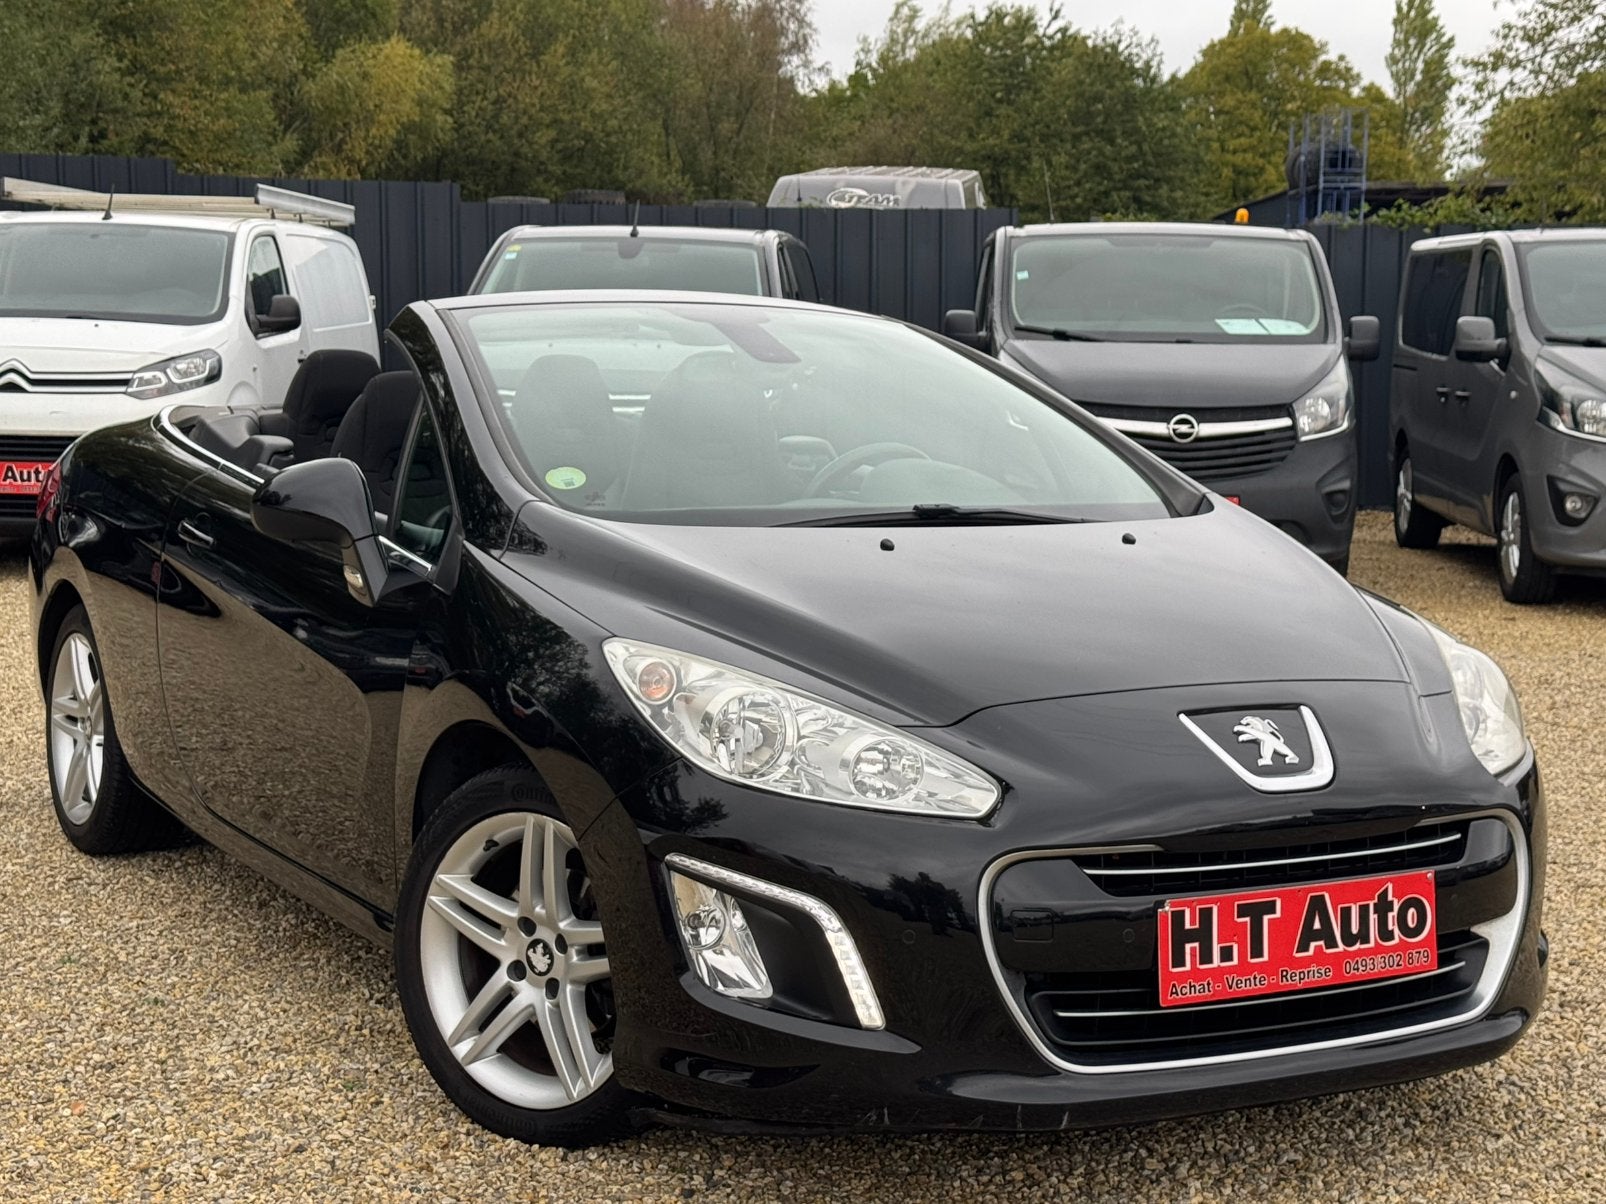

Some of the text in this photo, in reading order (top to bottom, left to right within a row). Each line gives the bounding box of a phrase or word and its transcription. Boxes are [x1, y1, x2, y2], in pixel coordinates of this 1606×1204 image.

[1, 463, 47, 485] Aut
[1168, 881, 1432, 972] H.T Auto
[1169, 979, 1212, 998] Achat
[1225, 972, 1266, 991] Vente
[1280, 965, 1332, 985] Reprise
[1407, 949, 1430, 966] 879
